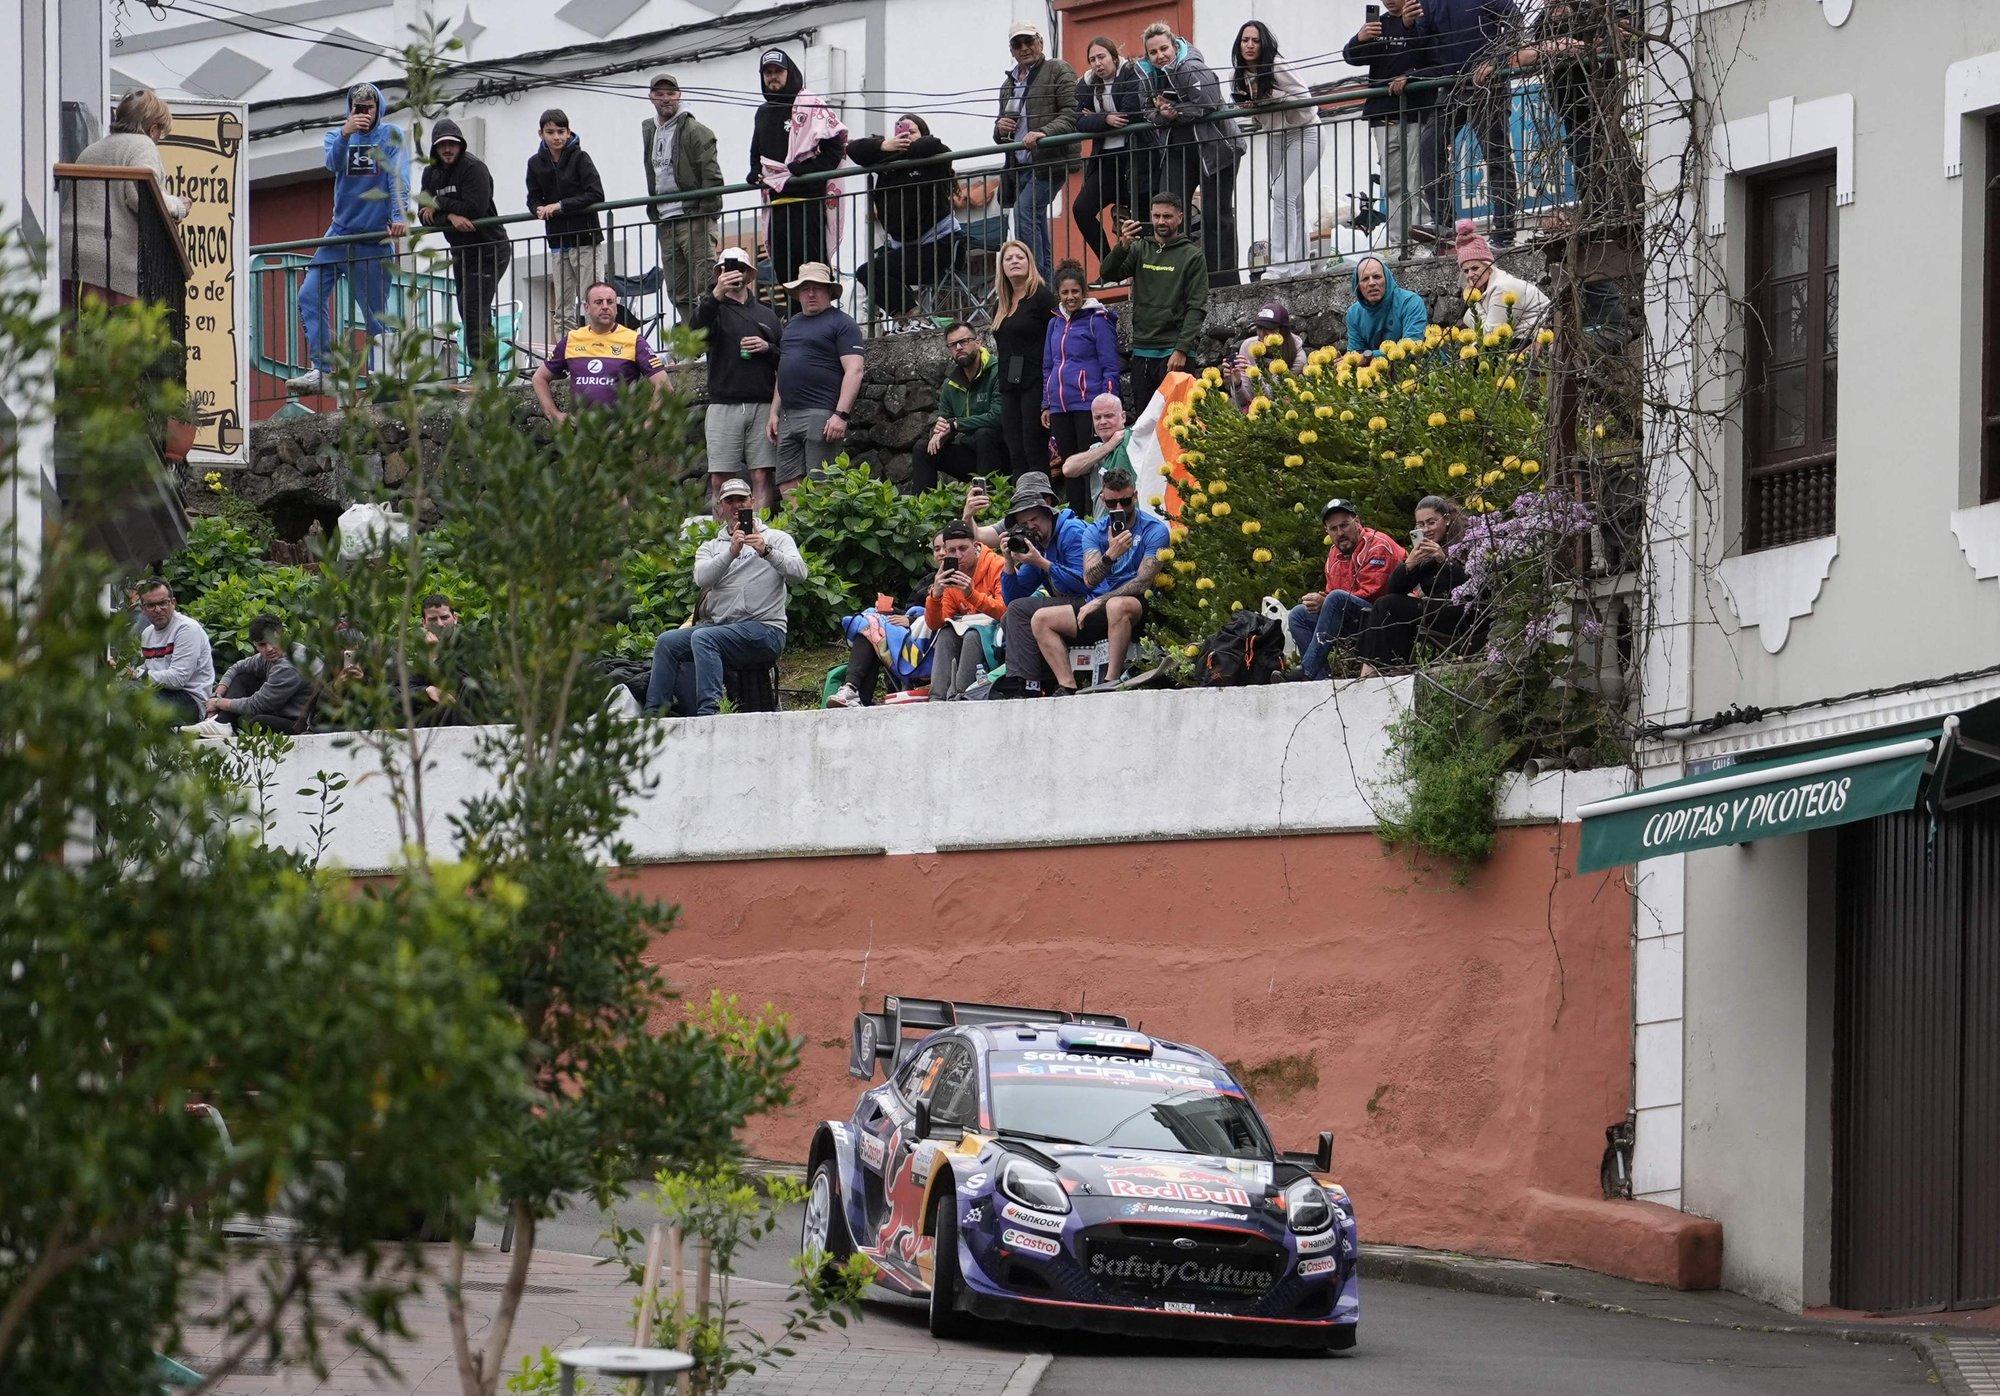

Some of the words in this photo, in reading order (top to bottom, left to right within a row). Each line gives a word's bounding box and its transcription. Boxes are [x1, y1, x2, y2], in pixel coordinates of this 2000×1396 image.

[204, 280, 225, 301] de
[196, 316, 215, 333] en
[575, 376, 614, 386] ZURICH
[1642, 801, 1728, 847] COPITAS
[1731, 797, 1750, 831] Y
[1746, 777, 1852, 829] PICOTEOS
[1023, 1051, 1201, 1075] SafetyCulture
[1147, 1204, 1208, 1216] Motorsport
[1210, 1209, 1248, 1221] Ireland
[1015, 1234, 1057, 1253] Castrol
[1089, 1253, 1273, 1288] SafetyCulture
[1306, 1258, 1335, 1272] Castrol
